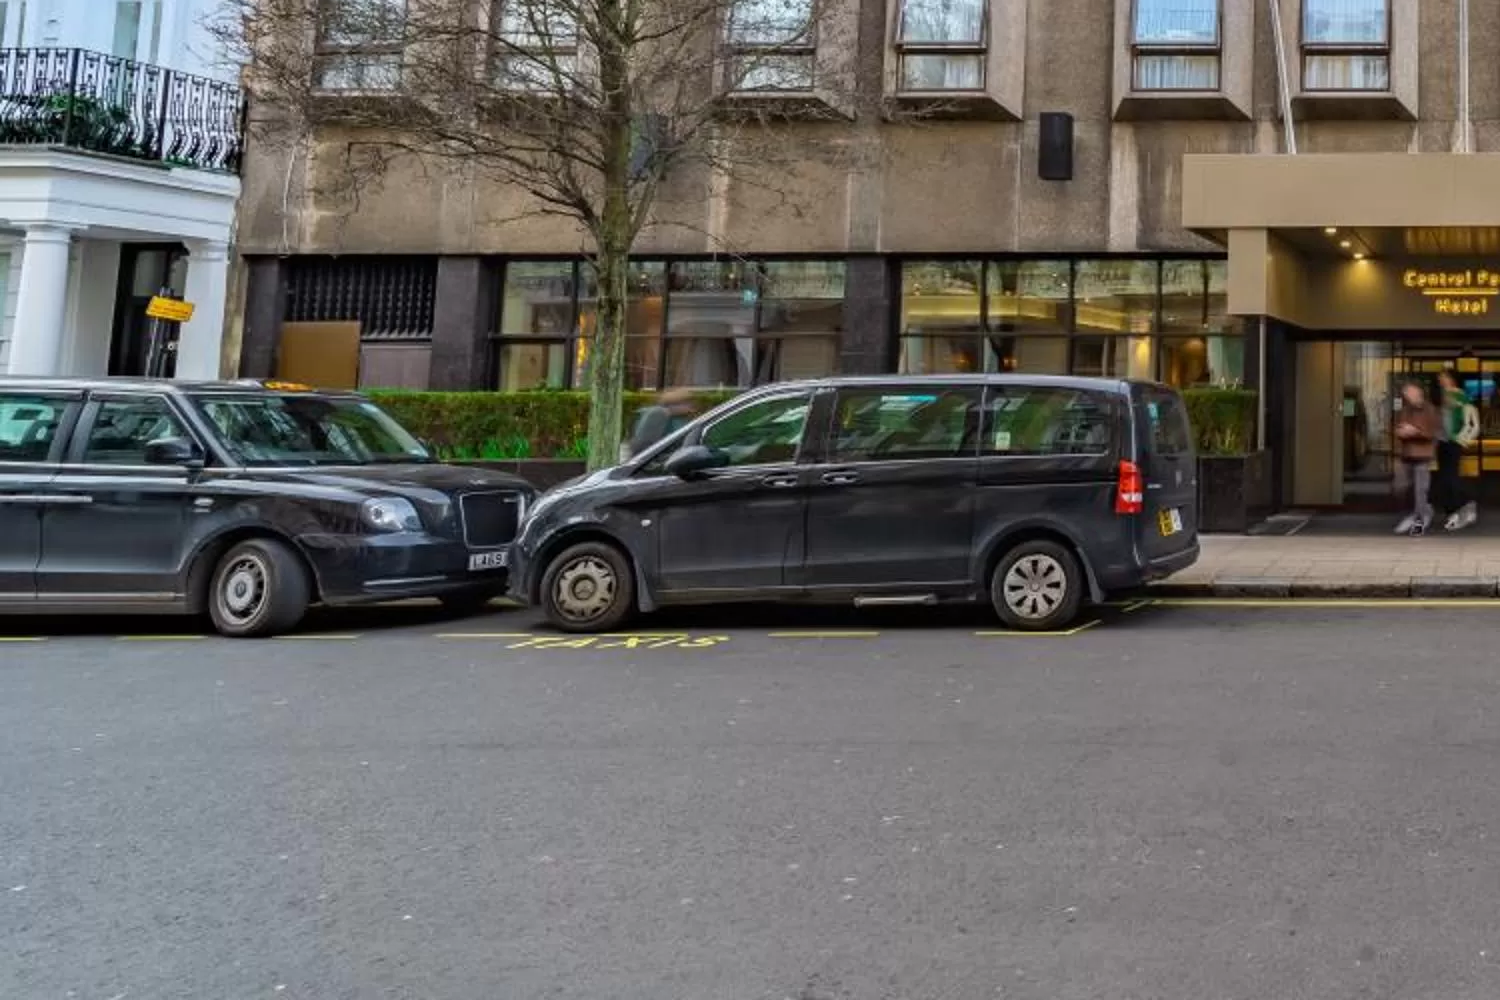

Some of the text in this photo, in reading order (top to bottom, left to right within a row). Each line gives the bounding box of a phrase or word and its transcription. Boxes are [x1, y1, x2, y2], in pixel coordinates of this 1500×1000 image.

[1404, 269, 1471, 287] Central
[1435, 298, 1488, 315] Hotel
[505, 635, 731, 649] TAXIS
